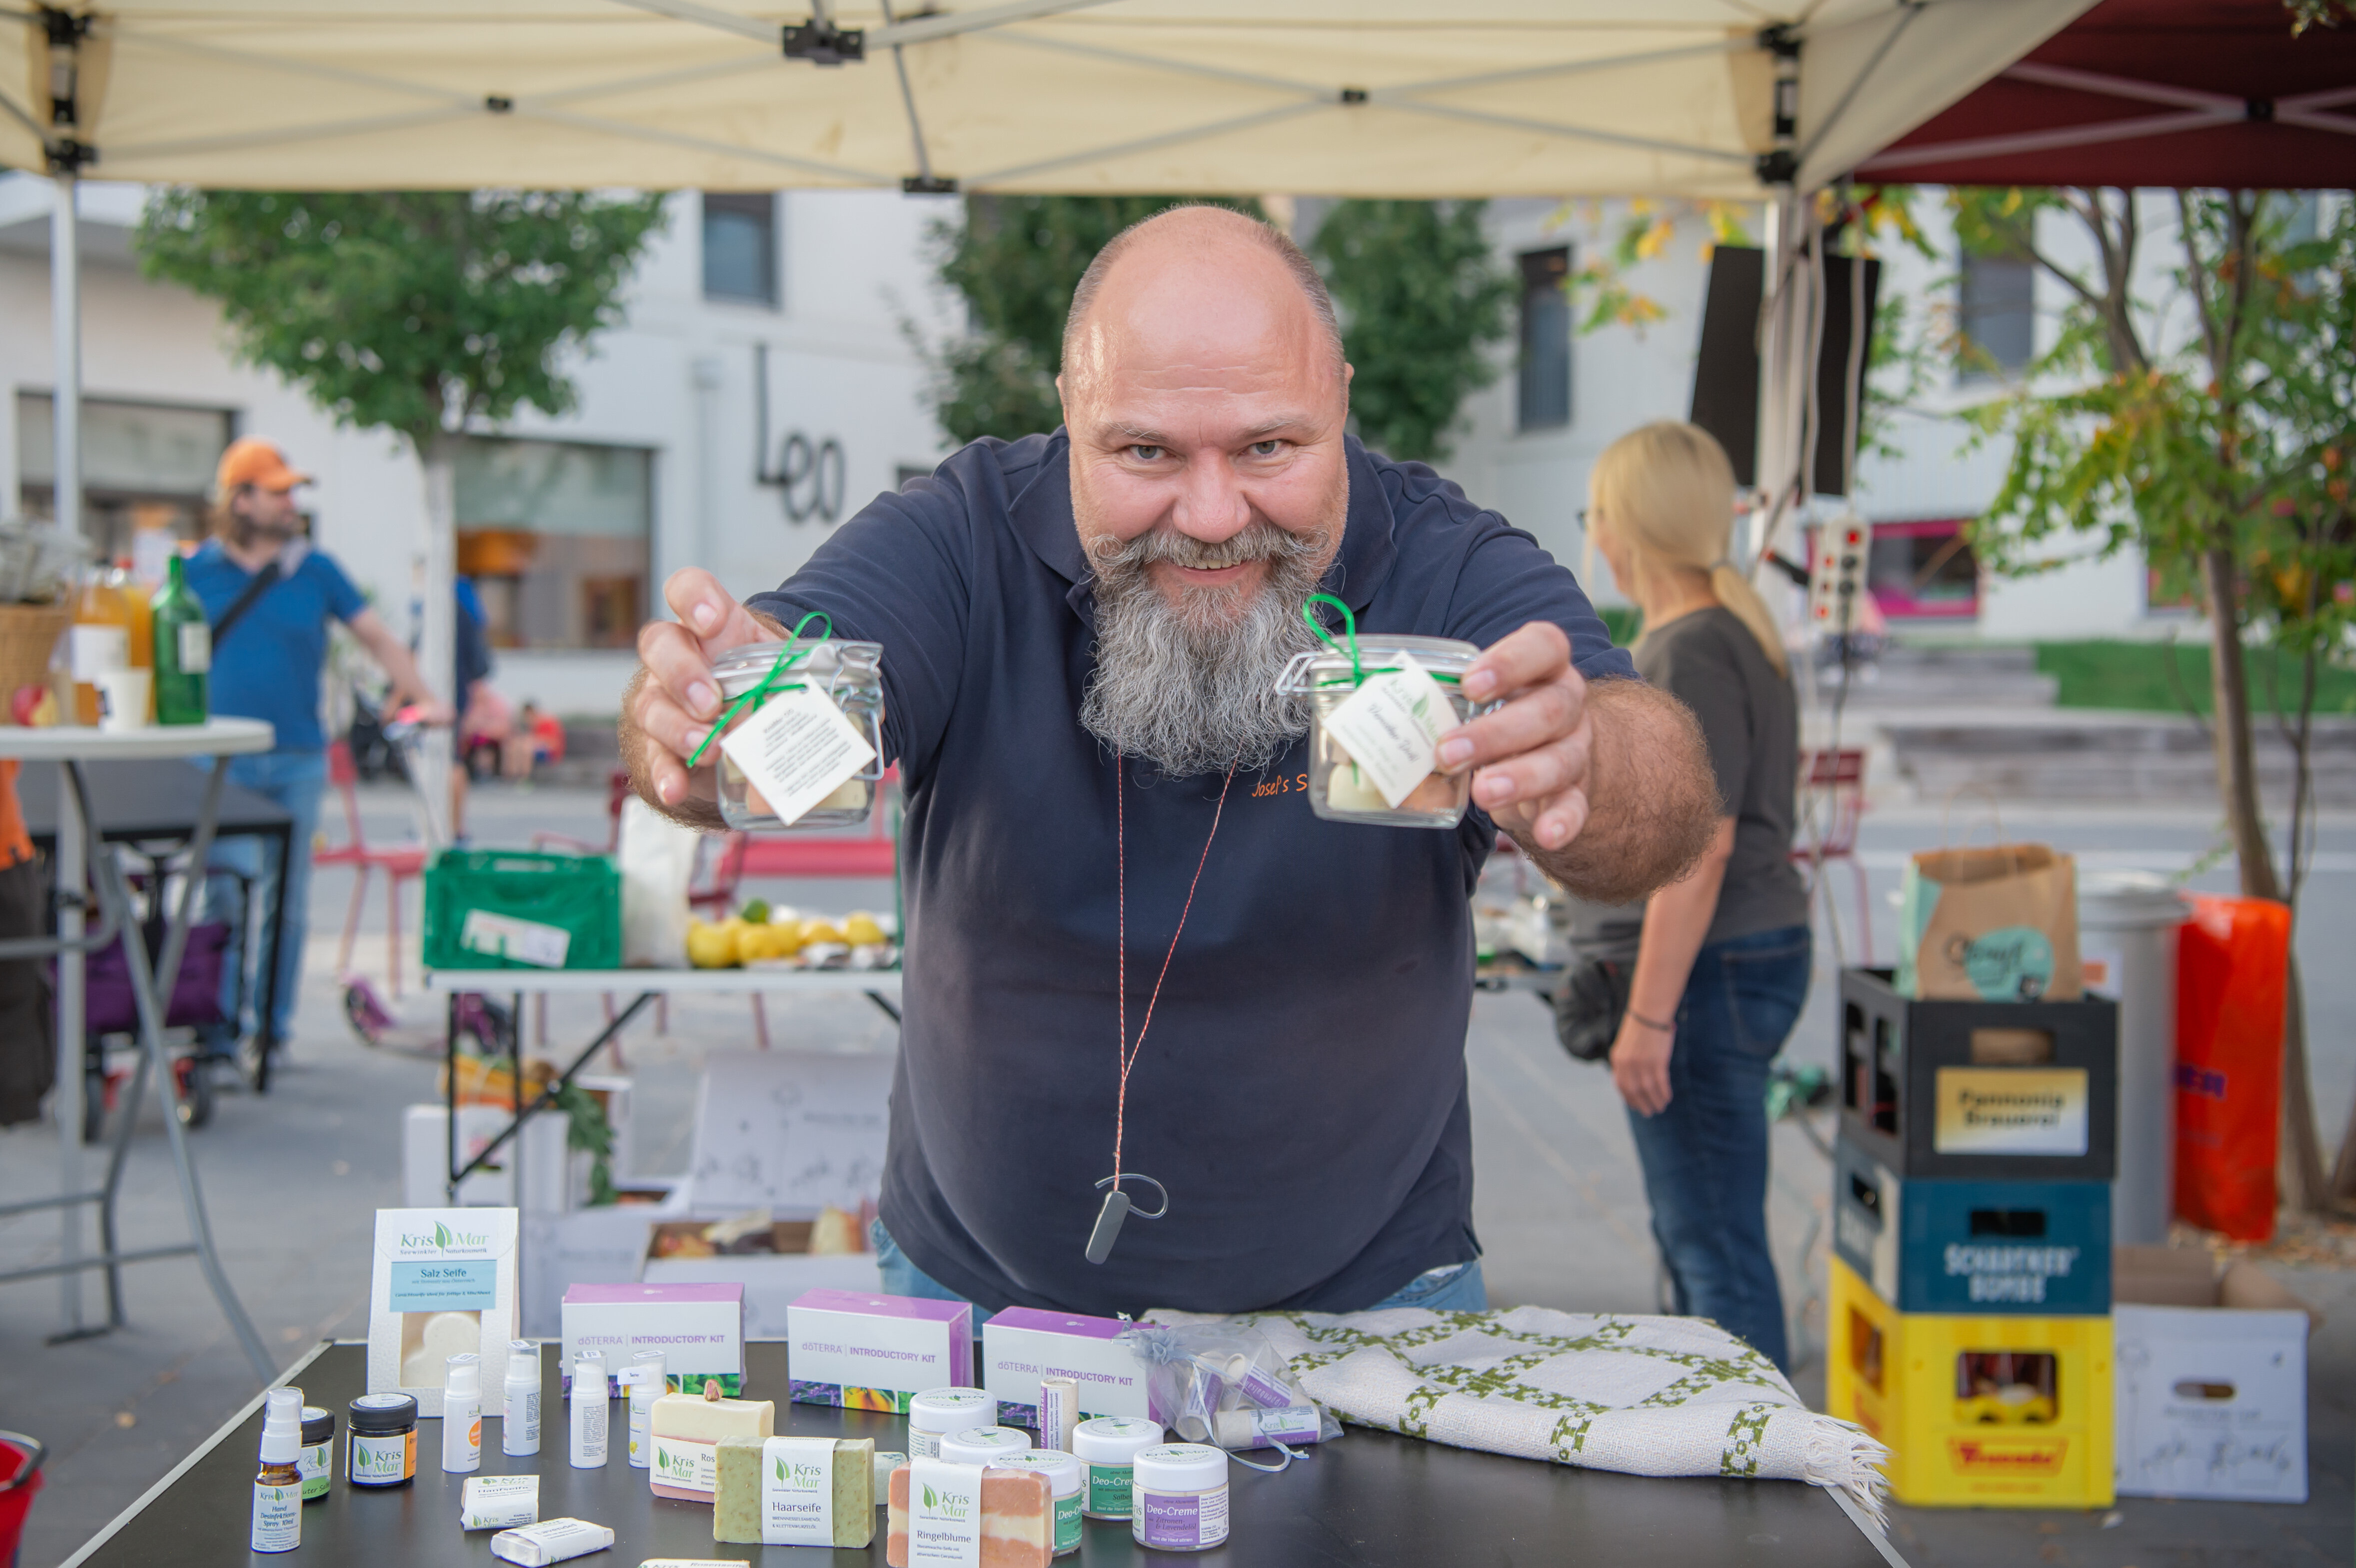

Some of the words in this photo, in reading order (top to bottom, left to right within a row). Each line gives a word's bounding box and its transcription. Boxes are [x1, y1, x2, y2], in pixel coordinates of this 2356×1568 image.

[753, 341, 846, 525] Leo
[400, 1233, 434, 1249] Kris
[455, 1232, 489, 1247] Mar
[420, 1269, 440, 1279] Salz
[443, 1268, 467, 1278] Seife
[631, 1335, 707, 1345] INTRODUCTORY
[710, 1335, 725, 1344] KIT
[850, 1347, 919, 1362] INTRODUCTORY
[922, 1354, 936, 1364] KIT
[1046, 1367, 1116, 1385] INTRODUCTORY
[1119, 1377, 1133, 1387] KIT
[374, 1451, 402, 1462] Kris
[672, 1455, 695, 1468] Kris
[701, 1453, 715, 1463] Ros
[373, 1462, 401, 1474] Mar
[671, 1466, 694, 1479] Mar
[794, 1463, 821, 1476] Kris
[792, 1476, 821, 1489] Mar
[1092, 1475, 1134, 1487] Deo-Cre
[942, 1491, 970, 1506] Kris
[772, 1502, 821, 1513] Haarseife
[940, 1504, 969, 1518] Mar
[1133, 1504, 1142, 1516] ris
[1147, 1504, 1198, 1517] Deo-Creme
[260, 1512, 296, 1521] Desinfektions-
[1155, 1516, 1185, 1525] Zitronen-
[917, 1530, 971, 1544] Ringelblume
